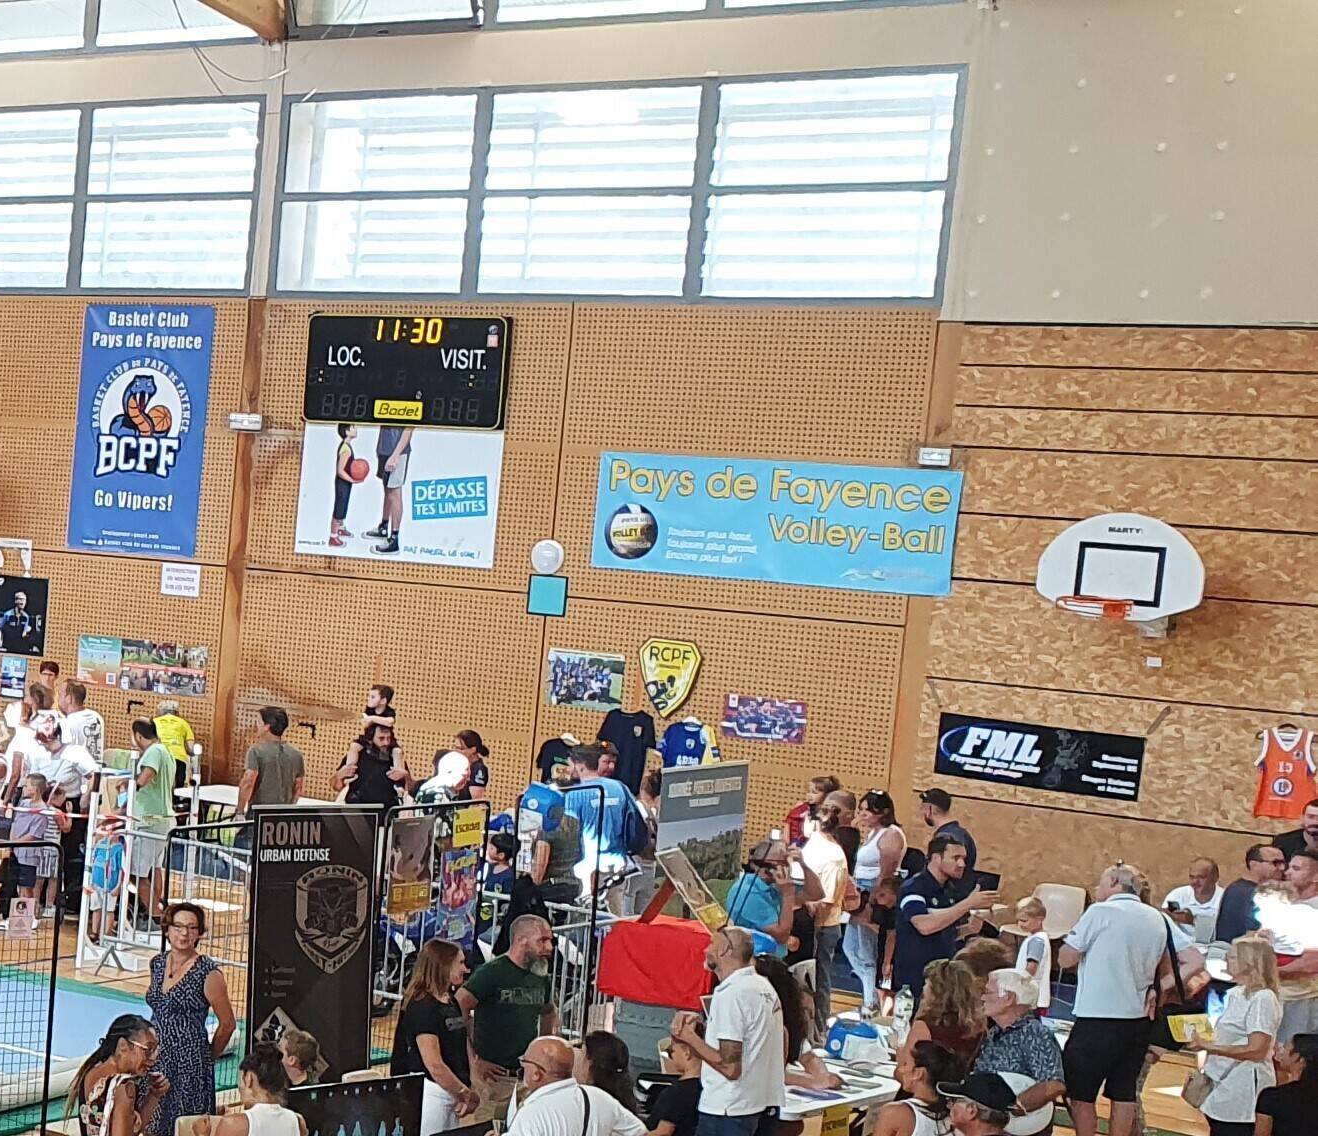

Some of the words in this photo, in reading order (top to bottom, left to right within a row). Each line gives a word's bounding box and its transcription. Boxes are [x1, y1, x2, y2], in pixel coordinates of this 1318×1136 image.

[109, 311, 154, 328] Basket
[157, 311, 189, 328] Club
[376, 317, 443, 344] 11:30
[92, 331, 123, 349] Pays
[125, 332, 143, 348] de
[146, 333, 203, 350] Fayence
[327, 345, 365, 367] LOC.
[440, 347, 487, 370] VISIT.
[95, 435, 181, 479] BCPF
[415, 480, 485, 501] DÉPASSE
[610, 459, 696, 501] Pays
[706, 466, 758, 500] de
[769, 467, 952, 513] Fayence
[94, 489, 114, 507] Go
[117, 490, 173, 511] Vipers!
[414, 503, 435, 516] TES
[438, 500, 485, 515] LIMITES
[768, 514, 947, 554] Volley-Ball
[649, 646, 692, 664] RCPF
[959, 726, 1043, 765] FML
[261, 821, 322, 846] RONIN
[260, 848, 292, 862] URBAN
[293, 847, 331, 861] DEFENSE
